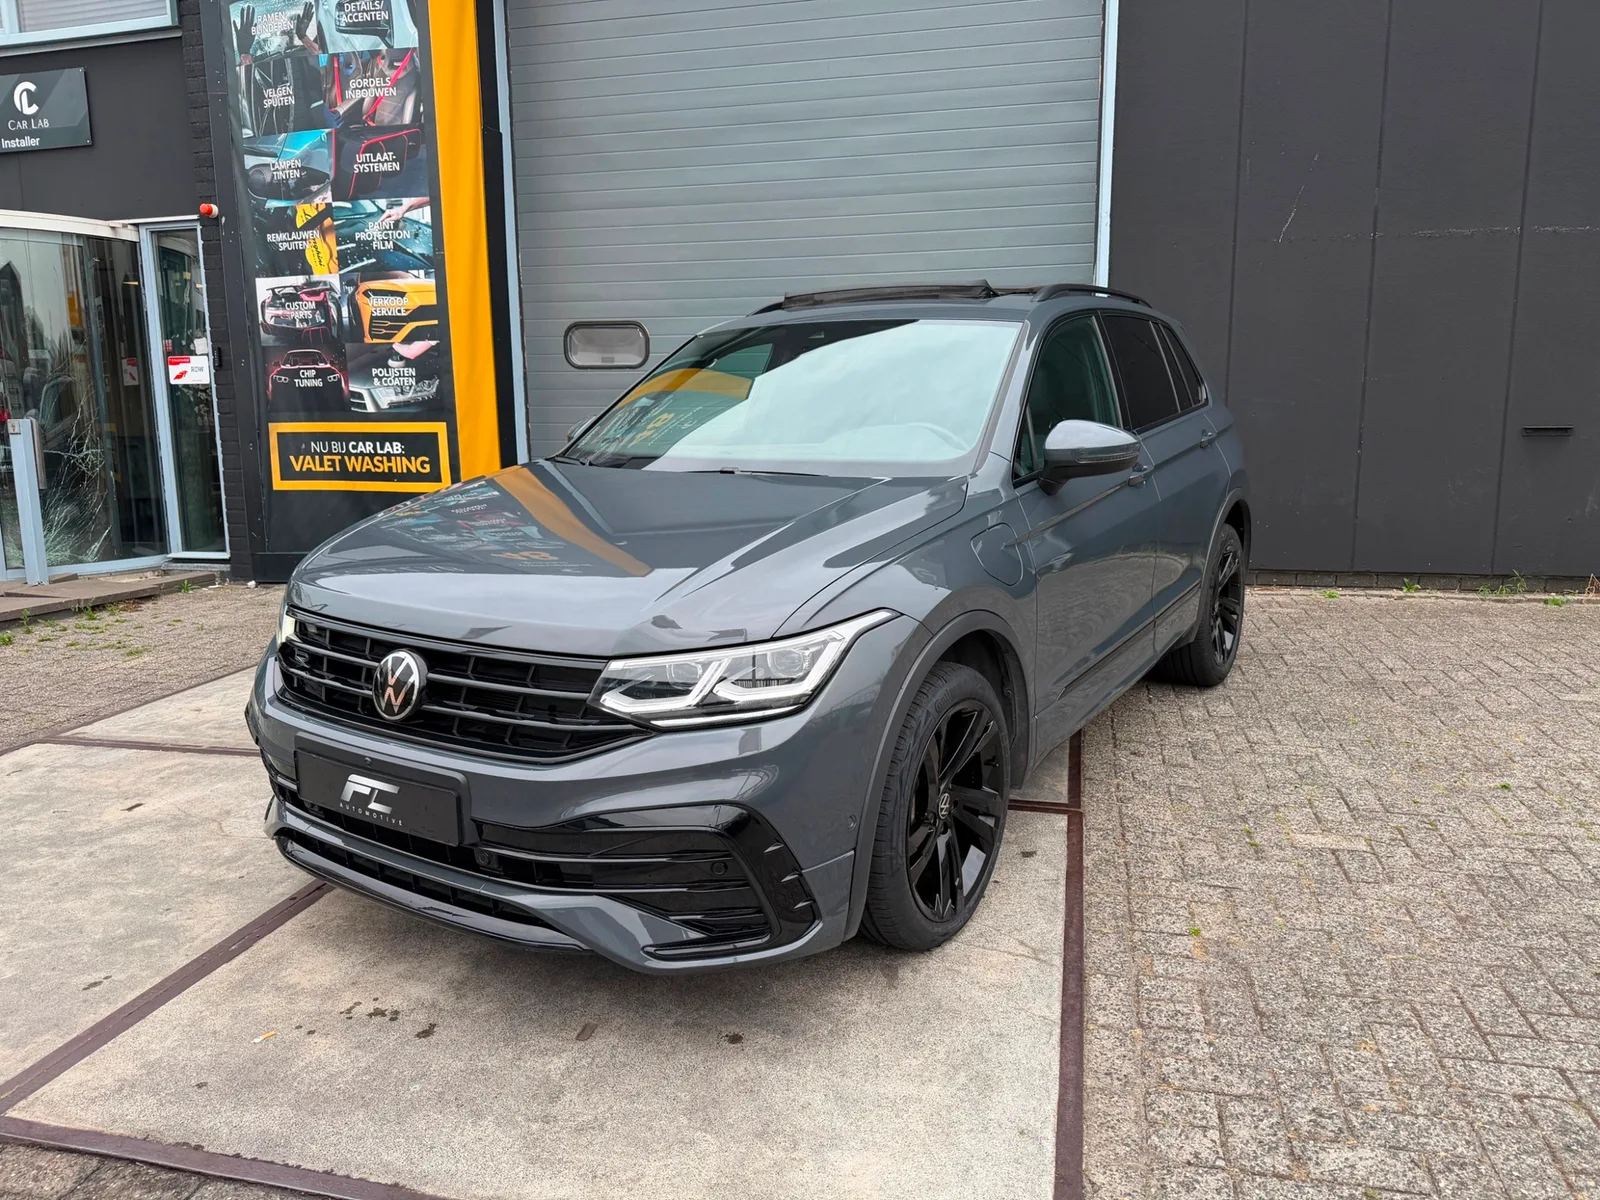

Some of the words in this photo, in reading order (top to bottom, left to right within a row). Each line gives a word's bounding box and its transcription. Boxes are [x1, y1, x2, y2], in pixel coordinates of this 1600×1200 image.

[344, 0, 384, 12] DETAILS/
[341, 11, 389, 23] ACCENTEN
[251, 20, 294, 36] BLINDEREN
[349, 77, 391, 90] GORDELS
[263, 87, 293, 99] VELGEN
[345, 87, 397, 100] INBOUWEN
[263, 97, 295, 109] SPUITEN
[7, 120, 28, 131] CAR
[31, 118, 50, 129] LAB
[1, 136, 40, 149] Installer
[356, 152, 397, 164] UITLAAT-
[270, 159, 302, 171] LAMPEN
[353, 161, 400, 174] SYSTEMEN
[272, 170, 300, 181] TINTEN
[368, 220, 395, 231] PAINT
[266, 230, 321, 243] REMKLAUWEN
[355, 230, 411, 241] PROTECTION
[278, 240, 310, 252] SPUITEN
[372, 240, 394, 250] FILM
[285, 300, 316, 311] CUSTOM
[367, 297, 409, 308] VERKOOP
[290, 310, 313, 320] PARTS
[371, 307, 407, 317] SERVICE
[299, 369, 317, 379] CHIP
[372, 368, 416, 379] POLIJSTEN
[294, 378, 323, 388] TUNING
[373, 377, 381, 387] &
[381, 377, 416, 387] COATEN
[311, 441, 329, 453] NU
[332, 441, 346, 453] BIJ
[348, 441, 374, 453] CAR
[376, 441, 405, 454] LAB:
[289, 455, 342, 472] VALET
[344, 456, 431, 474] WASHING
[339, 802, 403, 827] AUTOMOTIVE
